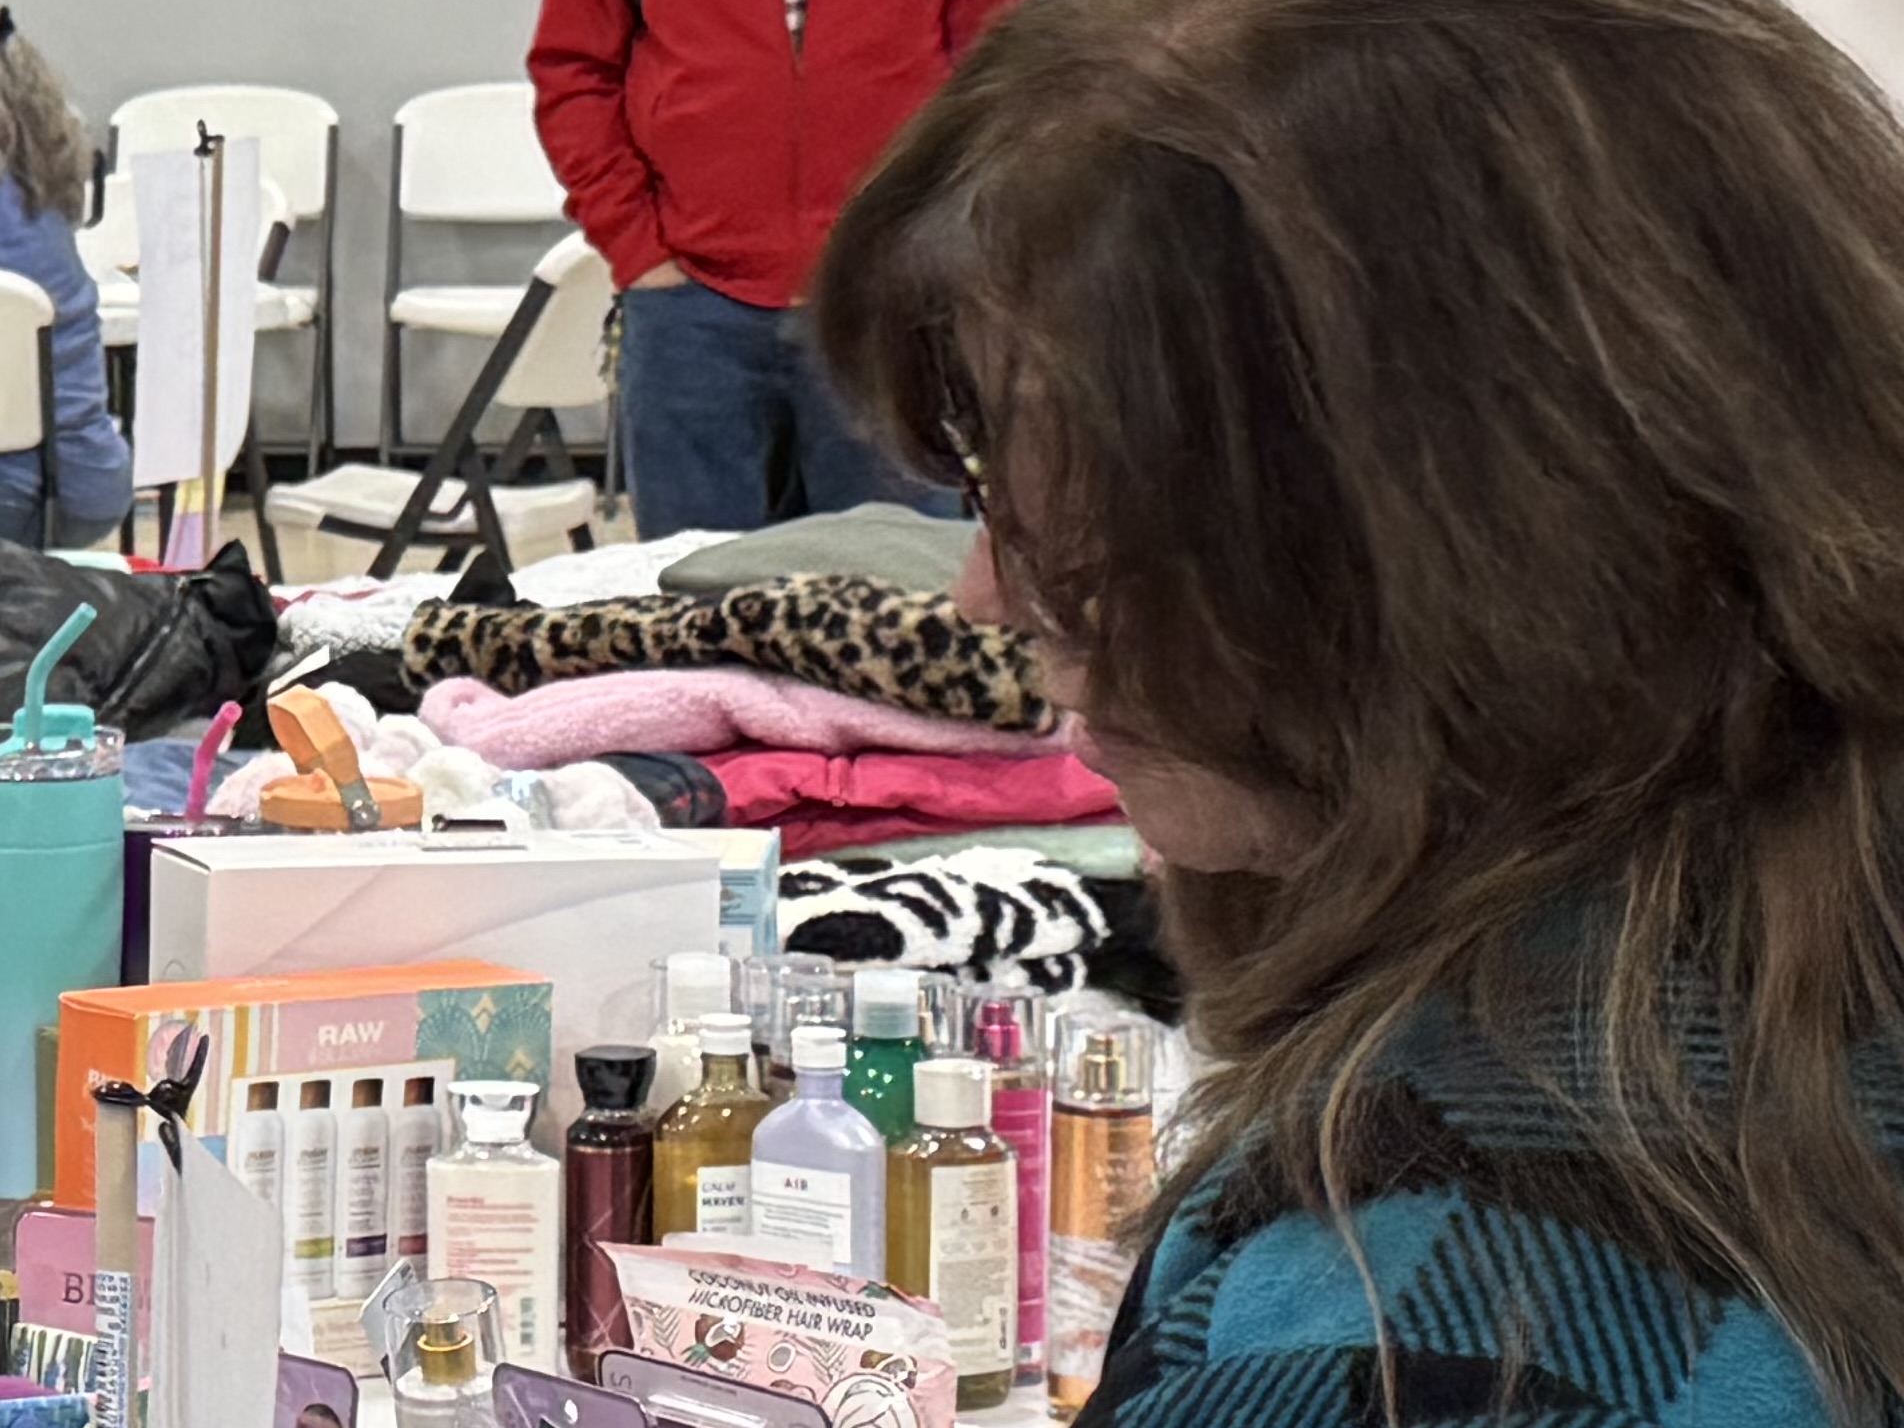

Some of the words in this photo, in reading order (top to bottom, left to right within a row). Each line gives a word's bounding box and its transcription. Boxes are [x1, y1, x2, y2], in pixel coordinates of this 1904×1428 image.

[317, 1020, 385, 1046] RAW
[688, 1289, 783, 1324] MICROFIBER
[786, 1309, 822, 1331] HAIR
[827, 1316, 873, 1341] WRAP
